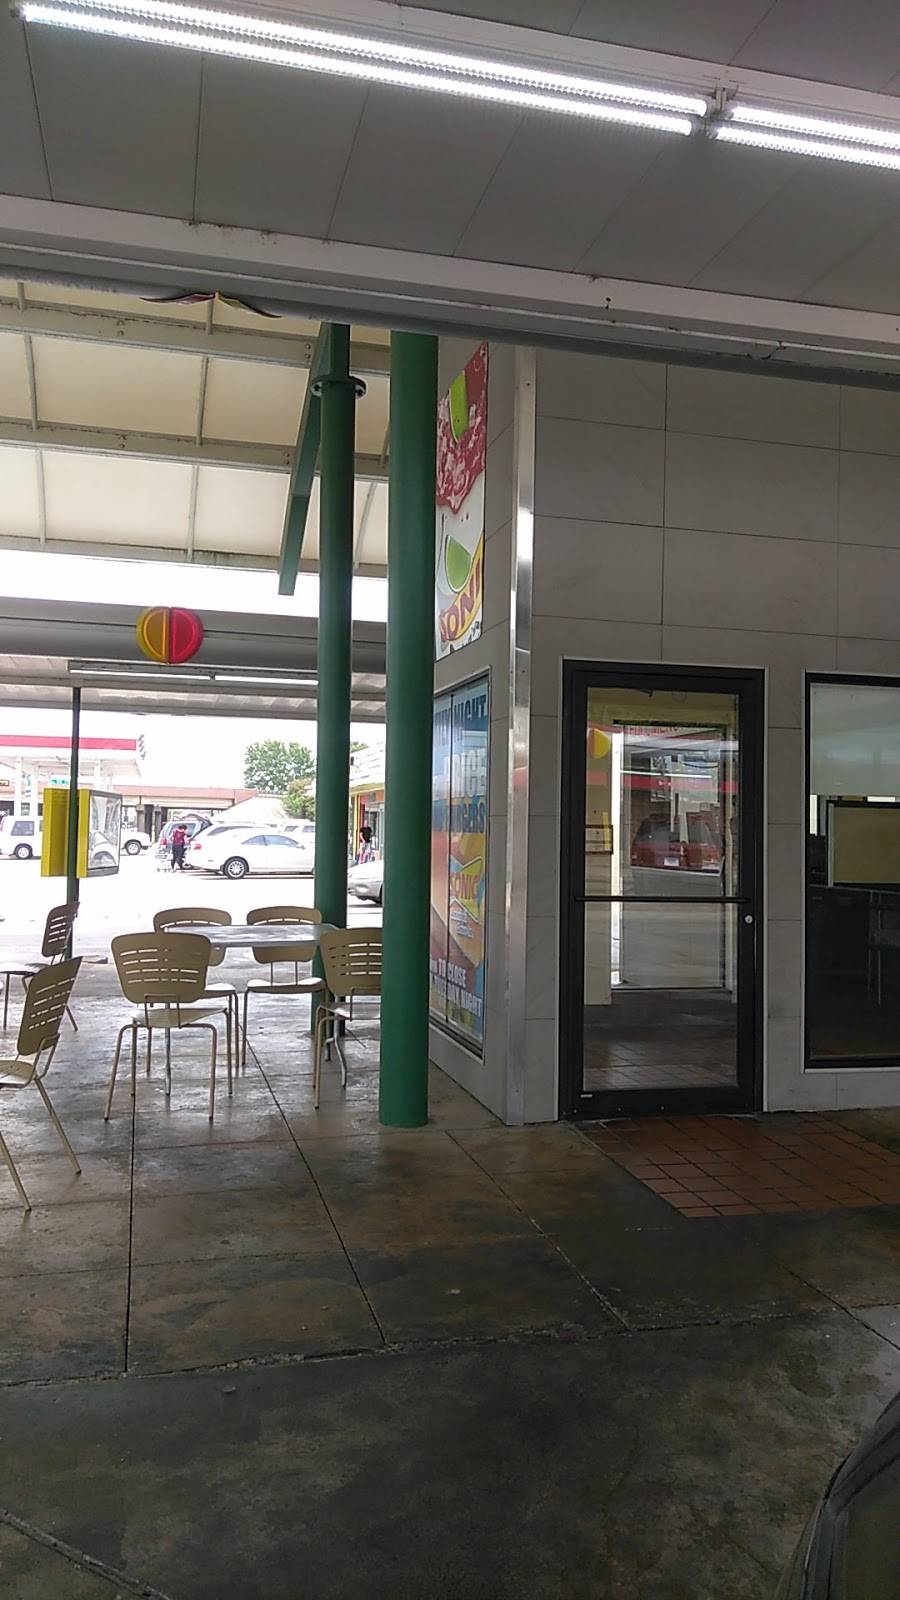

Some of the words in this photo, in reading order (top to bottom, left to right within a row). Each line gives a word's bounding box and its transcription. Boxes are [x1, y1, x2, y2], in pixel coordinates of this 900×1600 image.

[454, 693, 487, 741] NIGHT
[450, 872, 480, 899] SONIC
[447, 961, 467, 988] CLOSE
[460, 989, 483, 1017] NIGHT
